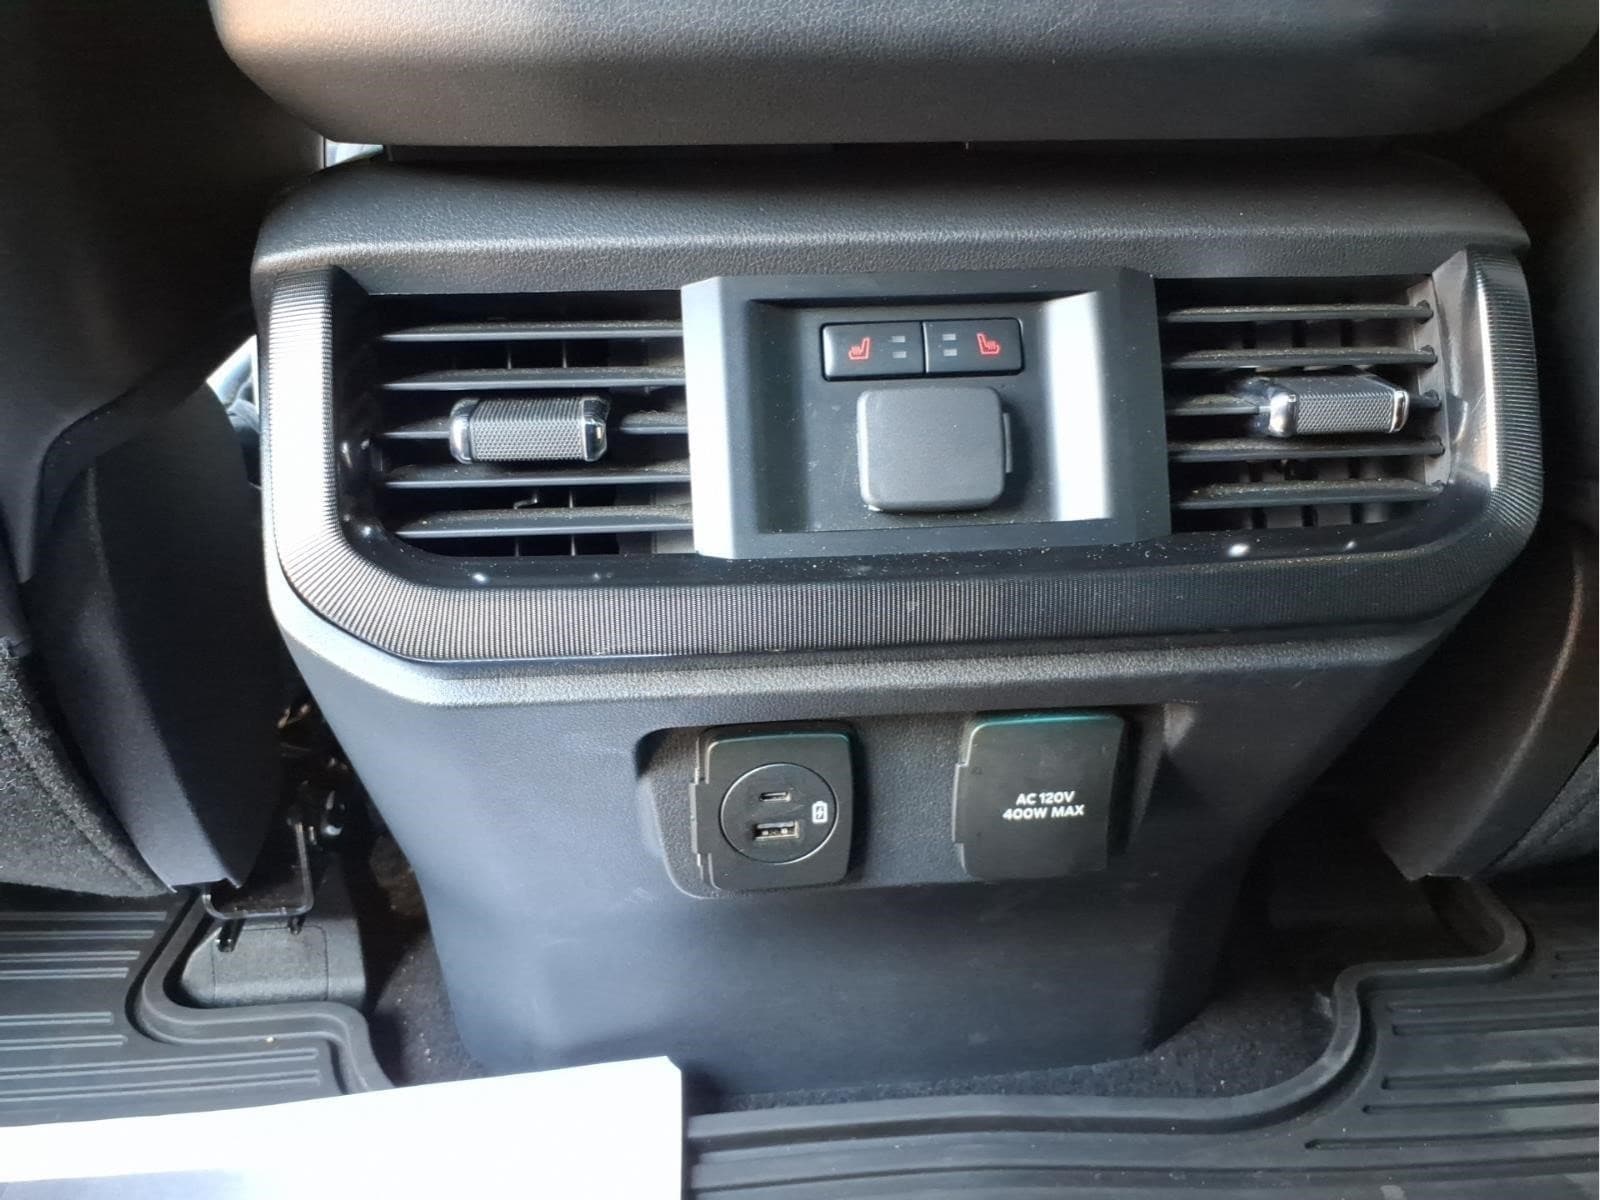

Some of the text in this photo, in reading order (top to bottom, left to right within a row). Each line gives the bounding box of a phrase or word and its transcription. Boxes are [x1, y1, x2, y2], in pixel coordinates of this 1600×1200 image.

[1016, 791, 1075, 806] AC 120V
[1002, 804, 1085, 820] 400W MAX
